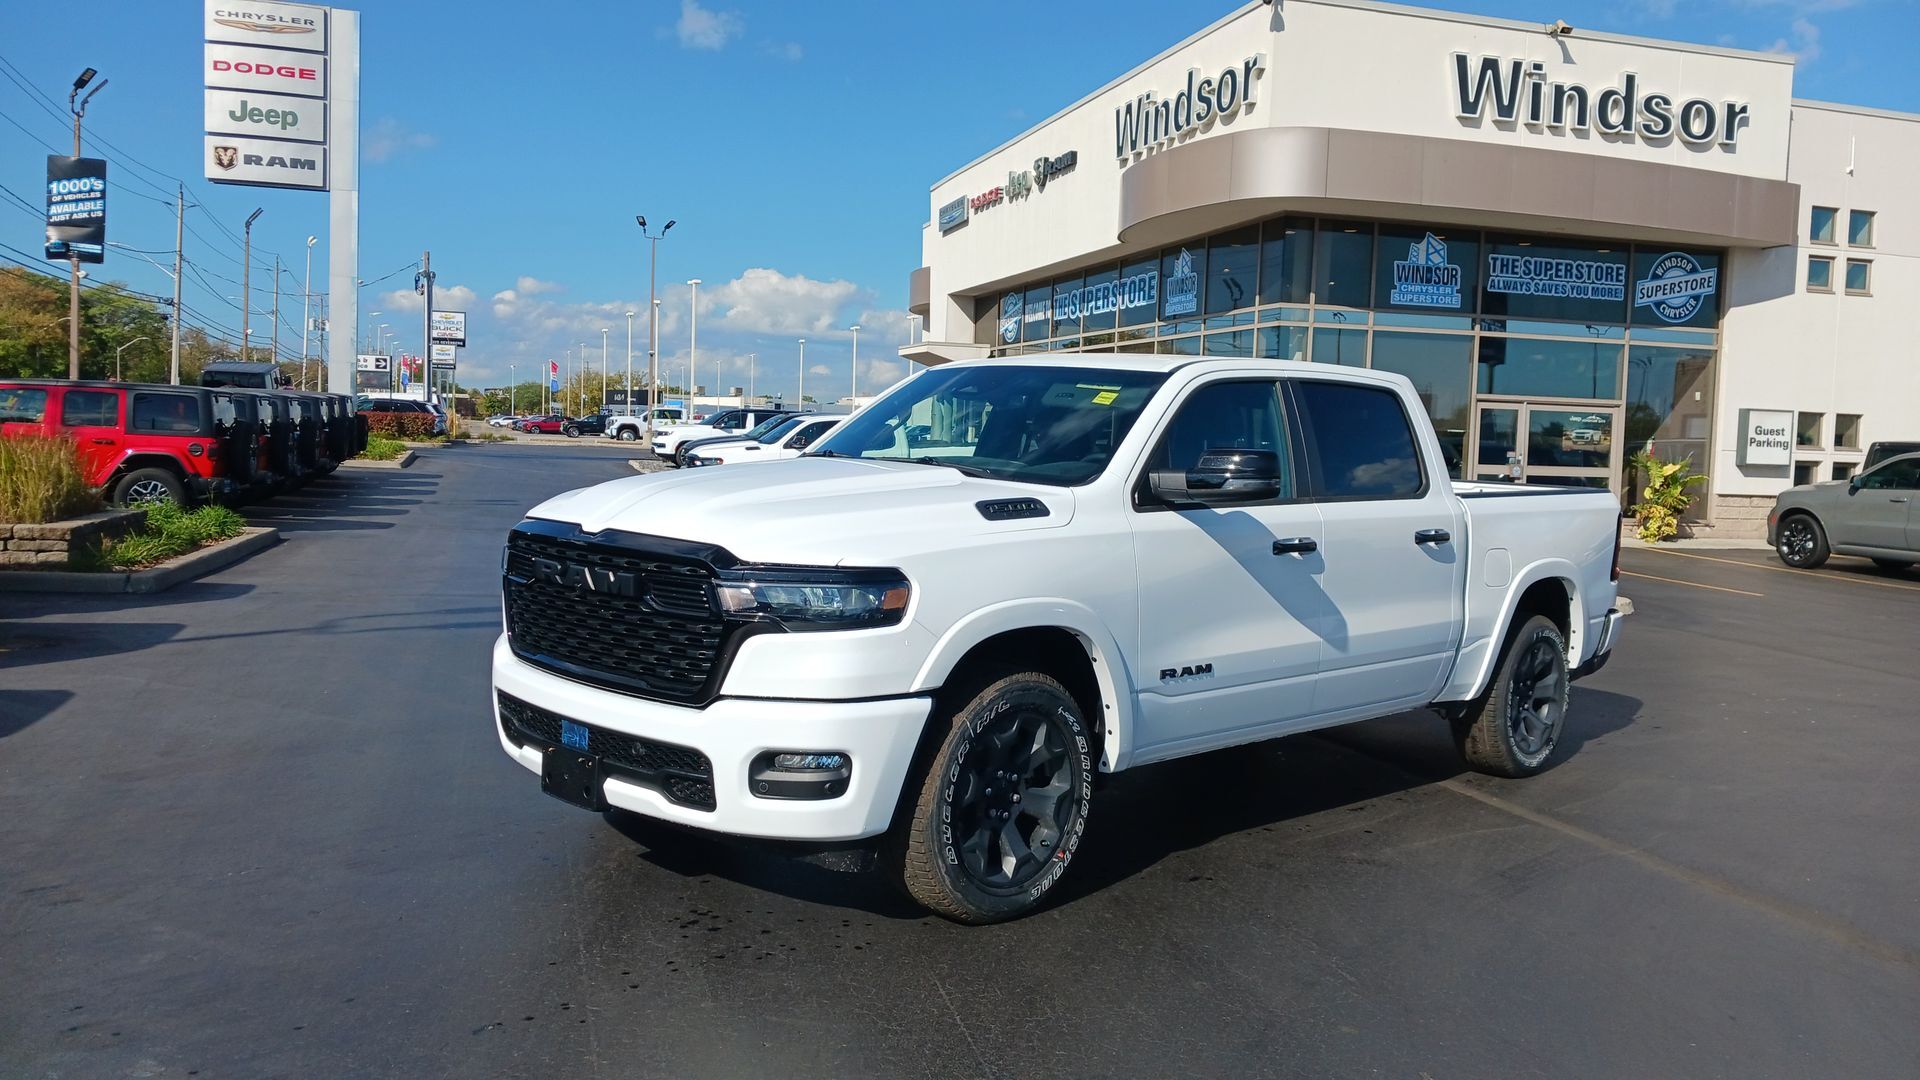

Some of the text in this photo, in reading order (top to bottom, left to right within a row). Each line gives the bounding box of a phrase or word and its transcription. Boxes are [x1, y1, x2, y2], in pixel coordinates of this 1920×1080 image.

[215, 10, 315, 26] CHRYSLER
[213, 60, 316, 80] DODGE
[1115, 53, 1265, 160] Windsor
[1454, 51, 1750, 144] Windsor
[228, 100, 298, 130] Jeep
[243, 154, 316, 171] RAM
[49, 178, 104, 194] 1000's
[52, 191, 101, 202] OF VEHICLES
[50, 201, 104, 214] AVAILABLE
[50, 210, 103, 222] JUST ASK US
[1396, 263, 1459, 286] WINDSOR
[1490, 256, 1625, 283] THE SUPERSTORE
[1655, 257, 1693, 276] WINDSOR
[1053, 294, 1069, 320] THE
[1069, 271, 1158, 319] SUPERSTORE
[1400, 284, 1452, 295] CHRYSLER
[1489, 279, 1623, 299] ALWAYS SAVES YOU MORE!
[1639, 275, 1713, 300] SUPERSTORE
[1393, 293, 1459, 304] SUPERSTORE
[1659, 298, 1697, 318] CHRYSLER
[1754, 425, 1786, 437] Guest
[1749, 437, 1789, 451] Parking
[534, 558, 637, 597] RAM
[1159, 663, 1213, 681] RAM
[941, 740, 971, 866] DUELER
[1030, 734, 1092, 901] BRIDGESTONE
